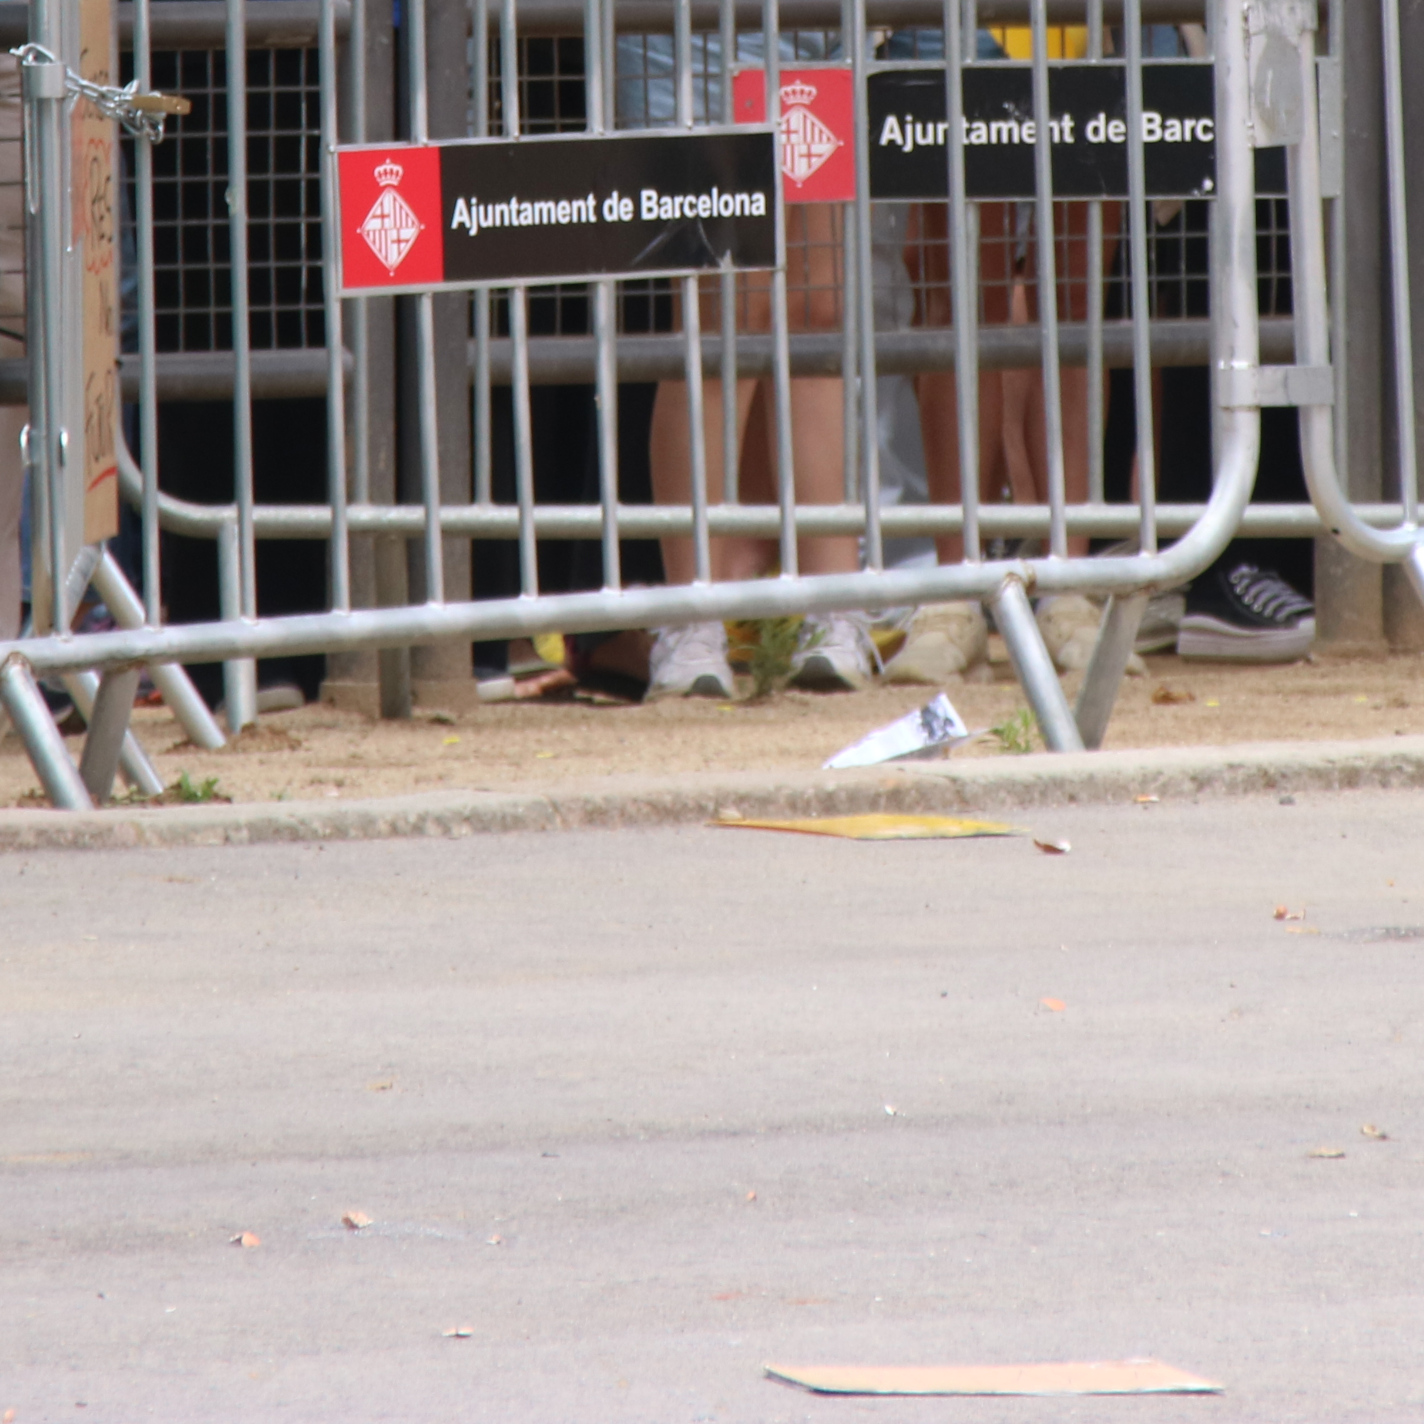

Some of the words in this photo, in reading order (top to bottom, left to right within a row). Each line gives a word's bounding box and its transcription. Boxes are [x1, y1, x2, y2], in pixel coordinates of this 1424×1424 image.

[1084, 112, 1127, 144] de
[450, 192, 598, 237] Ajuntament
[602, 190, 635, 222] de
[640, 185, 767, 221] Barcelona
